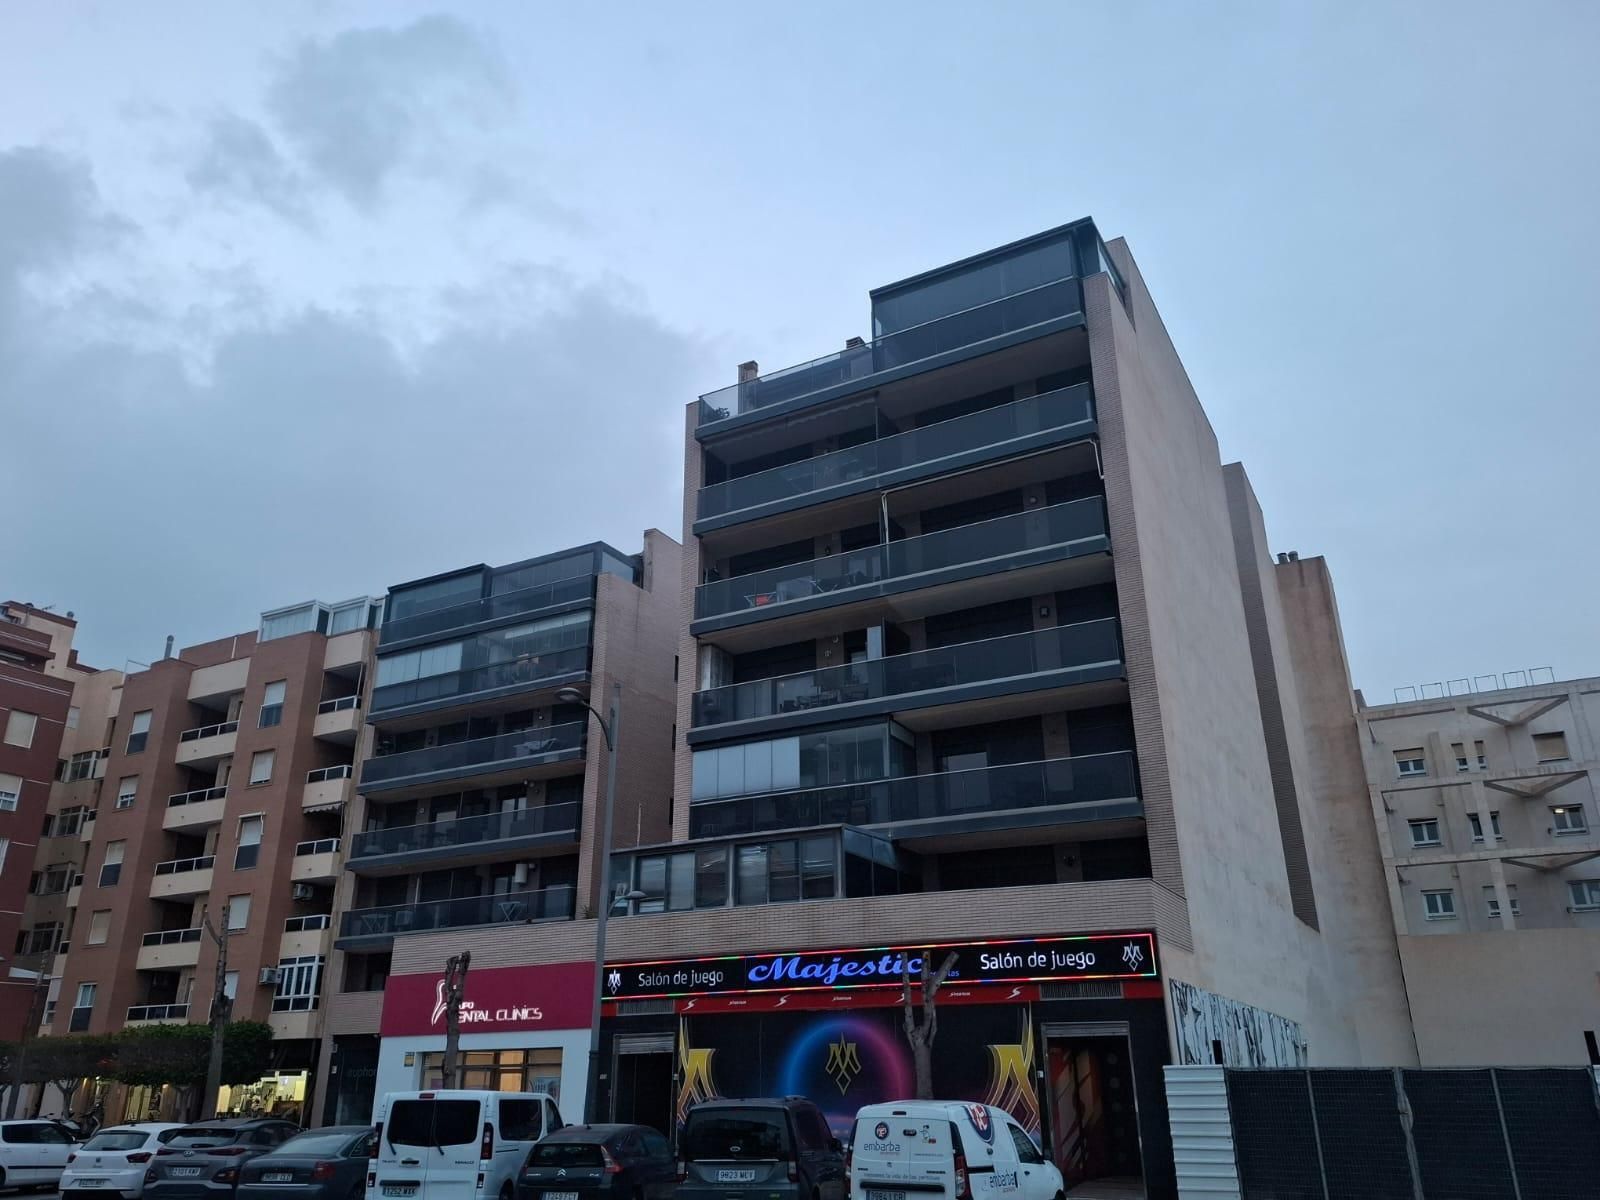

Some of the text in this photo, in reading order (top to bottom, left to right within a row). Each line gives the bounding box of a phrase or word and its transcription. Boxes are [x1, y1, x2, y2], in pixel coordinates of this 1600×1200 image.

[748, 953, 923, 985] Majestic
[980, 950, 1096, 970] Salón de juego
[638, 969, 724, 988] Salón de juego
[458, 1010, 494, 1024] ENTAL
[863, 1140, 901, 1152] embarba
